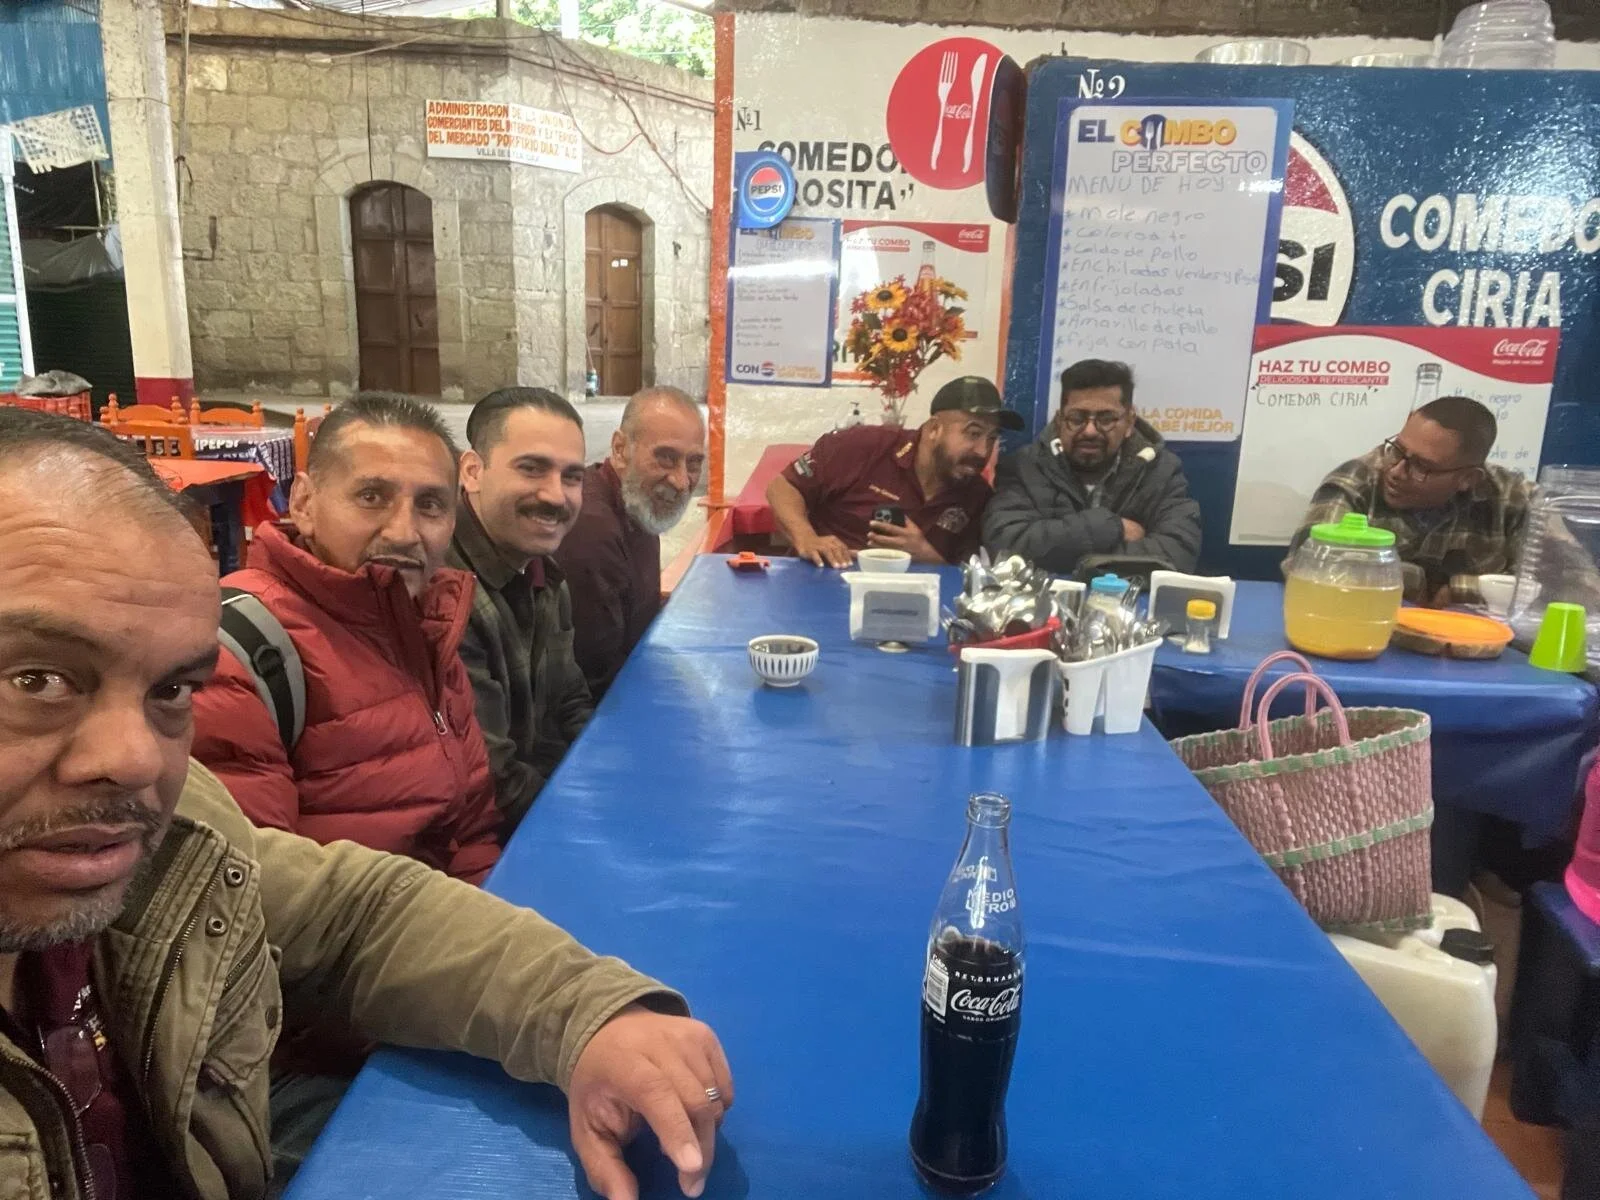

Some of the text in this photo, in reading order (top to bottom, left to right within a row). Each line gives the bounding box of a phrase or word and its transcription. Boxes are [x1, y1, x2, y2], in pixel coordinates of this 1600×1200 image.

[429, 101, 509, 117] ADMINISTRACION
[427, 116, 487, 130] COMERCIANTES
[489, 119, 504, 132] DEL
[1077, 119, 1115, 143] EL
[428, 130, 444, 144] DEL
[447, 132, 490, 146] MERCADO
[1111, 151, 1268, 174] PERFECTO
[750, 182, 783, 195] PEPSI
[1069, 175, 1131, 196] MENU
[1141, 176, 1165, 195] DE
[1422, 268, 1562, 328] CIRIA
[736, 364, 759, 374] CON
[1259, 360, 1391, 374] HAZ TU COMBO
[1260, 375, 1389, 385] DELICIOSO Y REFRESCANTE
[1141, 408, 1223, 420] LA COMIDA
[1153, 421, 1234, 434] ABE MEJOR
[950, 983, 1022, 1016] Coca-Cola
